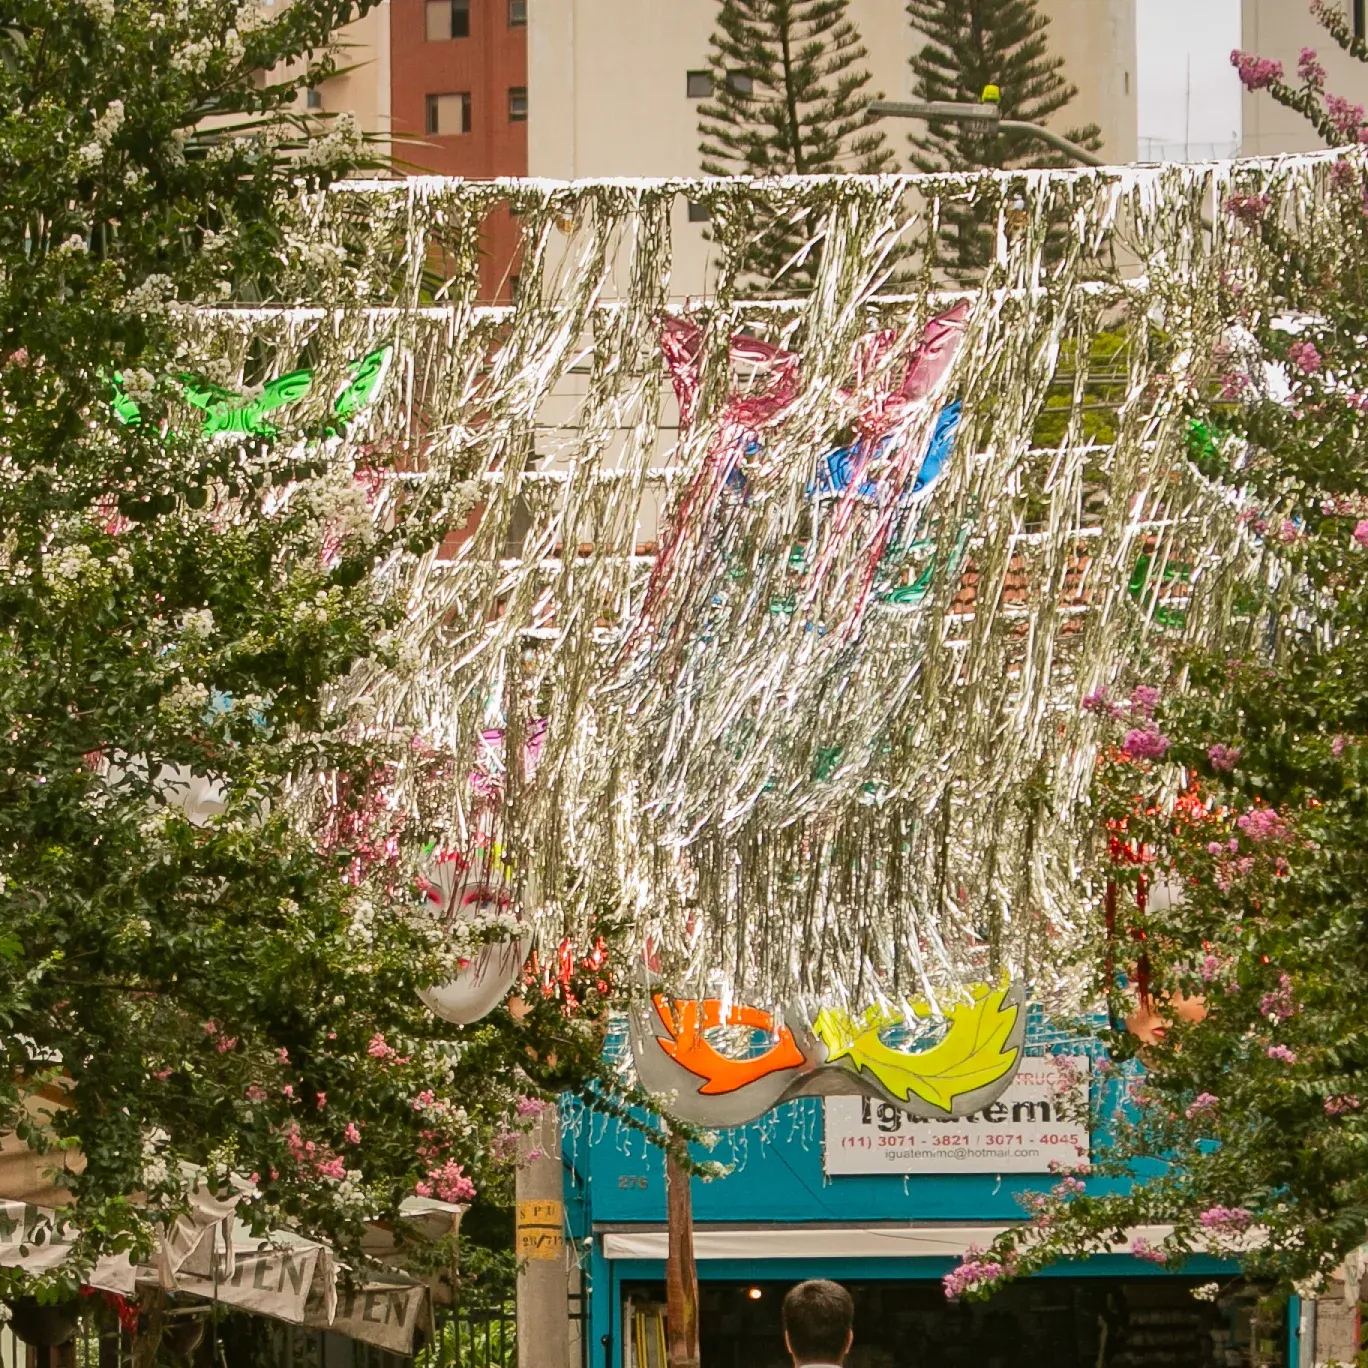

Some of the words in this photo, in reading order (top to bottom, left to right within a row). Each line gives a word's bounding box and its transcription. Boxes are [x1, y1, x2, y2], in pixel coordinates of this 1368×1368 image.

[841, 1136, 872, 1148] (11)
[878, 1136, 916, 1147] 3071
[932, 1136, 970, 1146] 3821
[985, 1135, 1023, 1146] 3071
[1039, 1134, 1078, 1145] 4045
